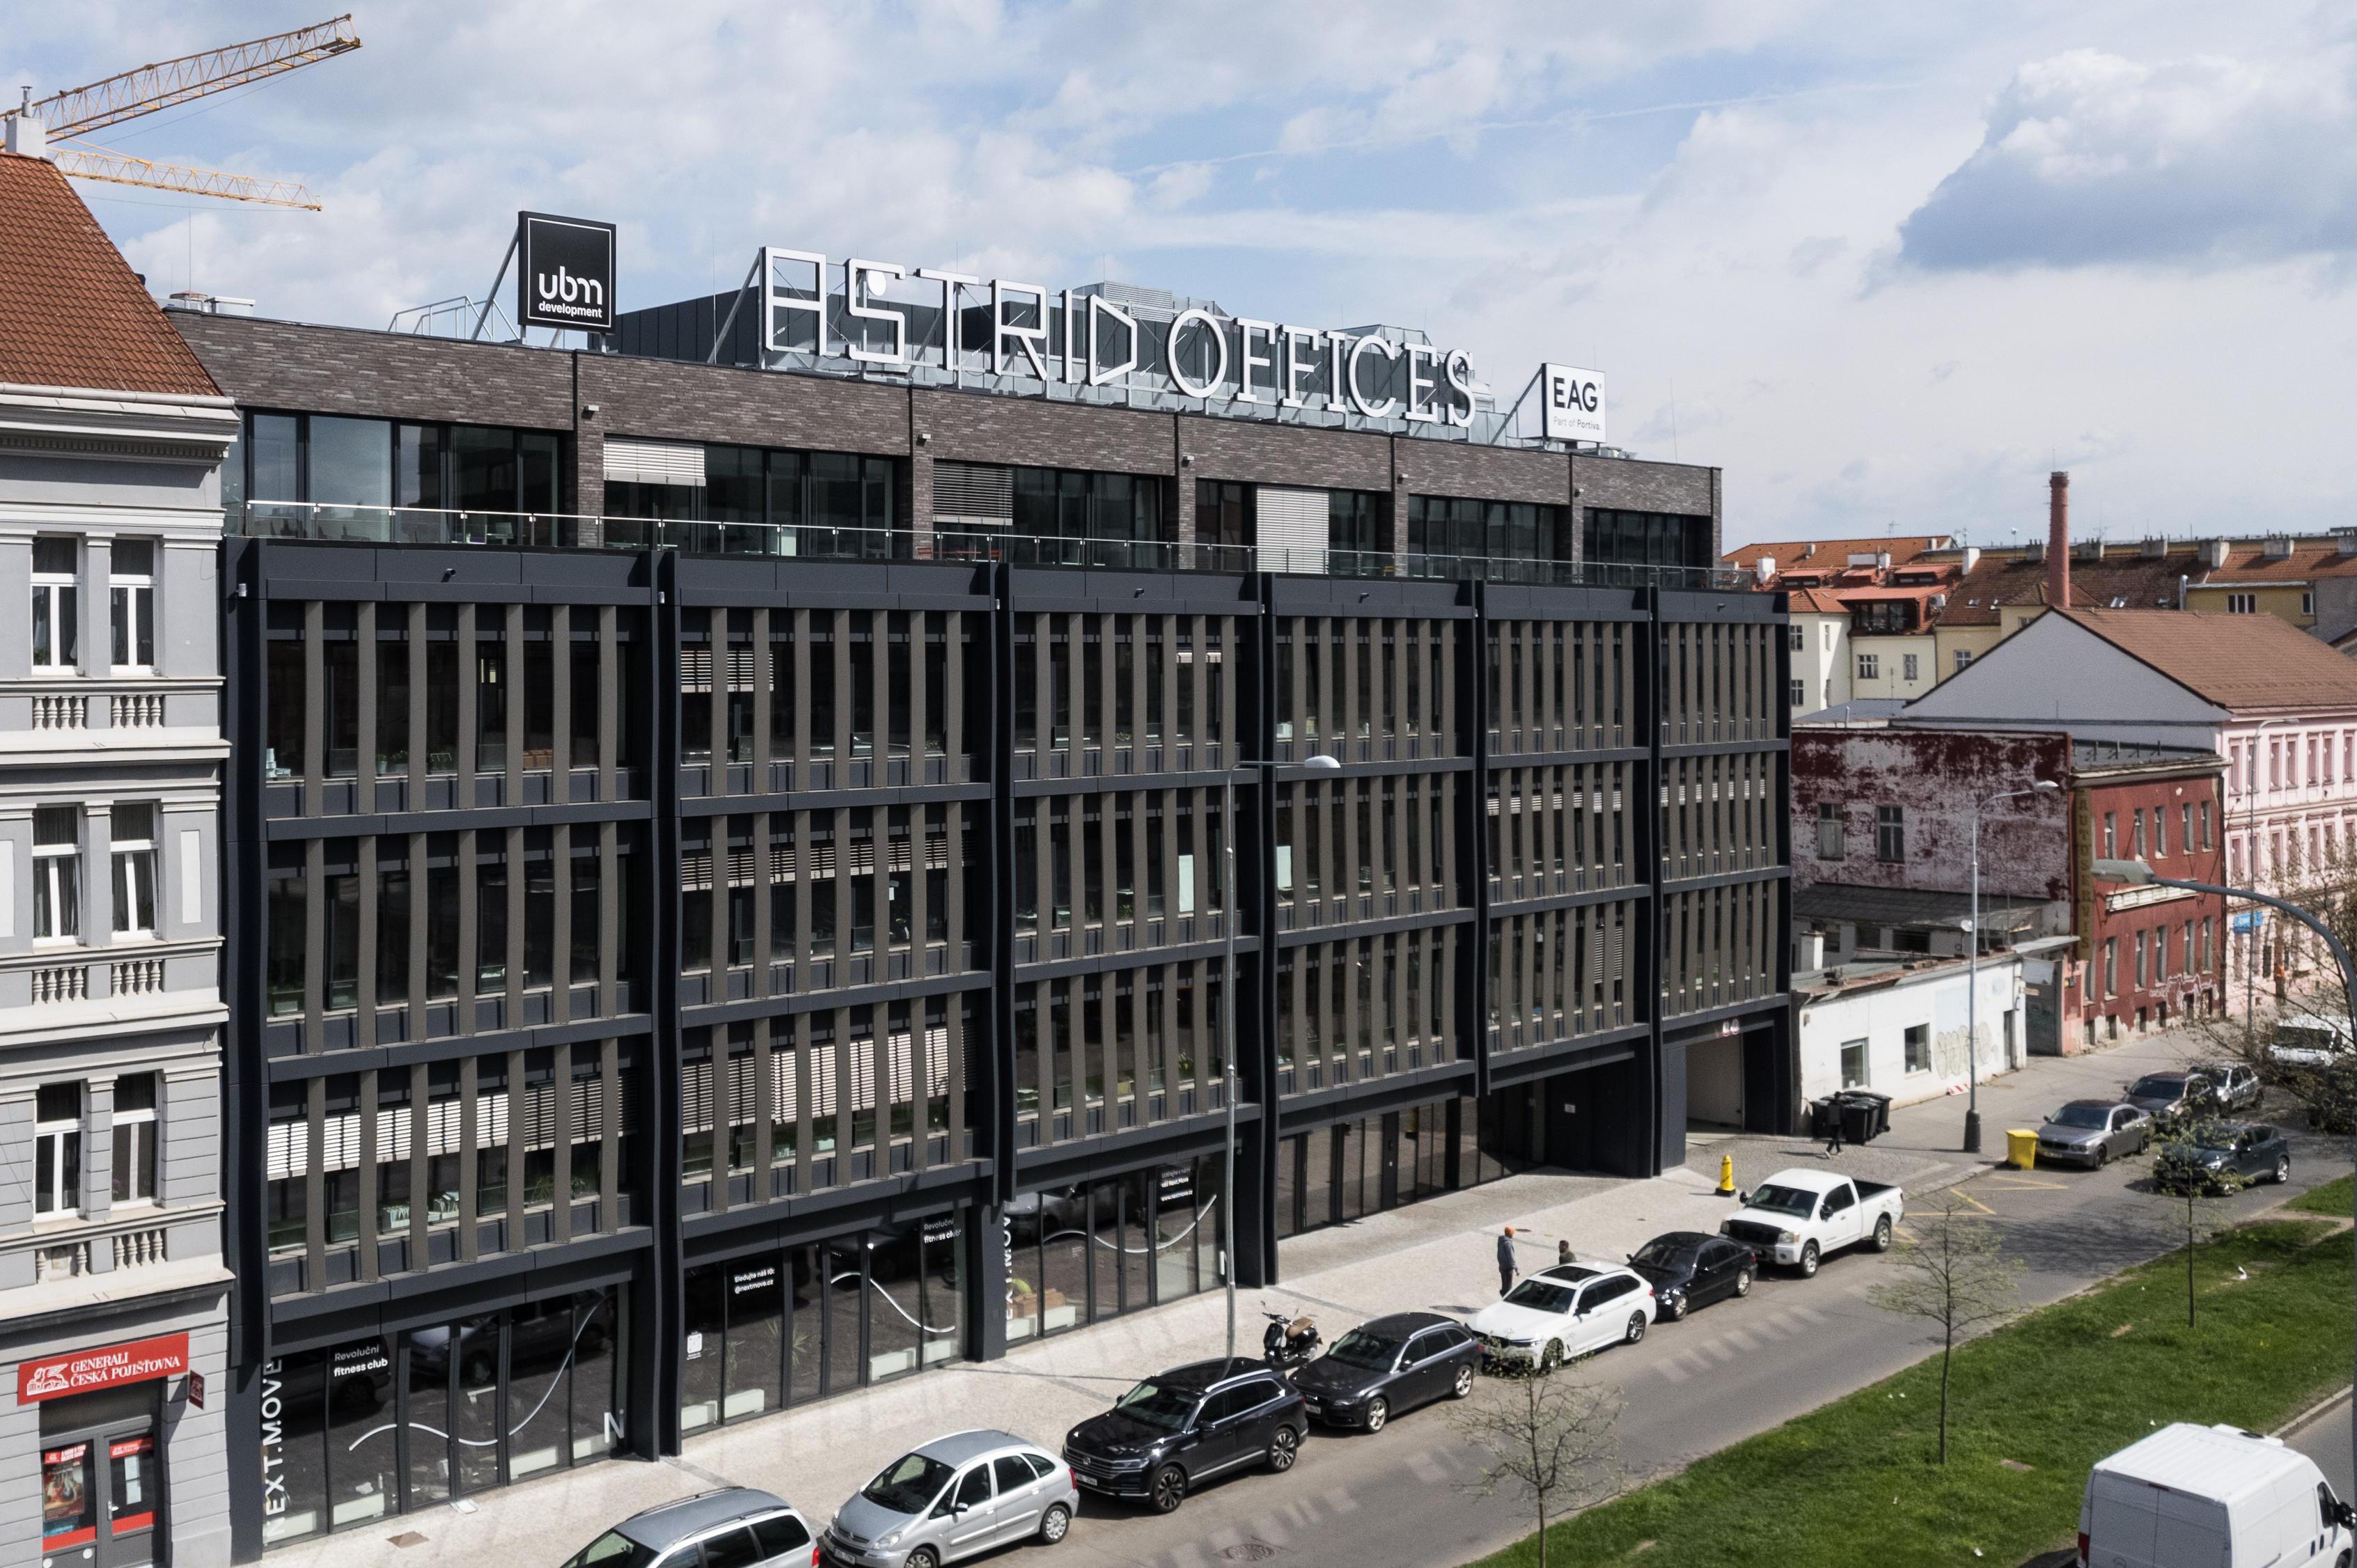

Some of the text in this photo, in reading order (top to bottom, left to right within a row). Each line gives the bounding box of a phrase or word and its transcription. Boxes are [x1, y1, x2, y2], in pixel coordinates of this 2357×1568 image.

[538, 265, 603, 305] ubm
[538, 301, 603, 318] development
[762, 246, 1475, 428] ASTRID OFFICES
[1553, 376, 1598, 413] EAG
[1553, 416, 1567, 426] Part
[1569, 418, 1576, 428] of
[924, 1233, 946, 1244] fitness
[70, 1352, 129, 1374] GENERALI
[334, 1344, 379, 1362] Revoluční
[70, 1356, 181, 1388] ČESKÁ POJIŠŤOVNA
[334, 1358, 389, 1377] fitness club
[262, 1359, 285, 1537] NEXT.MOVE
